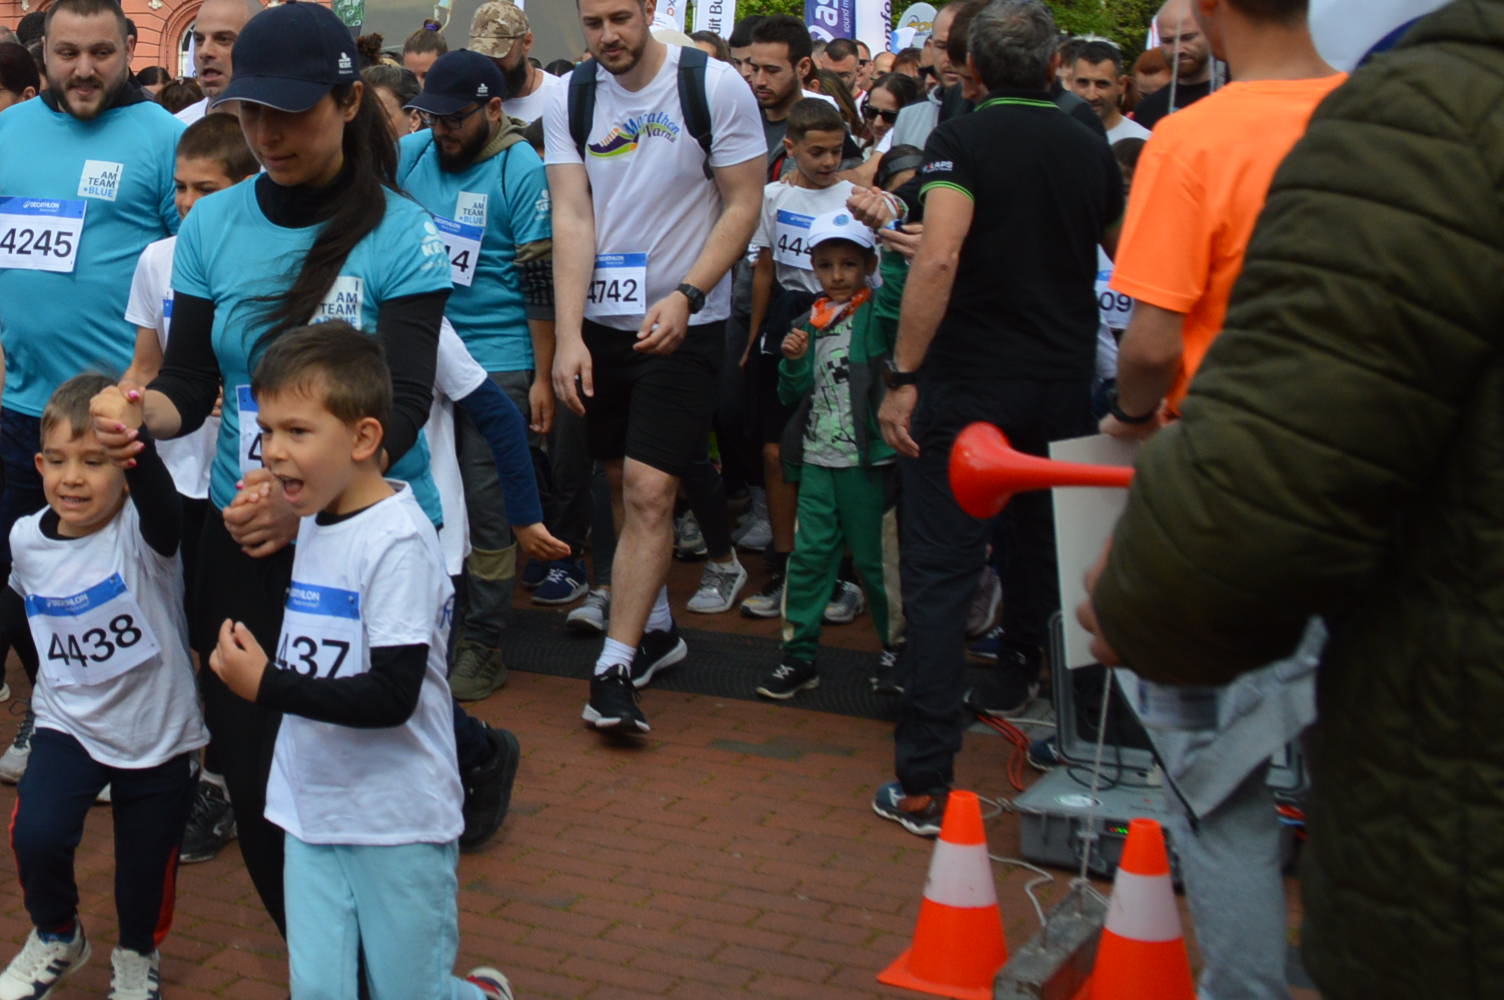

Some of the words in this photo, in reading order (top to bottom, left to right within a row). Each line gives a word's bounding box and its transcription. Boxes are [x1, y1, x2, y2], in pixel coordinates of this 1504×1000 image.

[100, 171, 118, 181] AM
[88, 177, 116, 188] TEAM
[463, 208, 484, 216] TEAM
[0, 227, 74, 258] 4245
[336, 291, 358, 303] AM
[587, 278, 638, 304] 4742
[320, 303, 356, 315] TEAM
[46, 613, 143, 668] 4438
